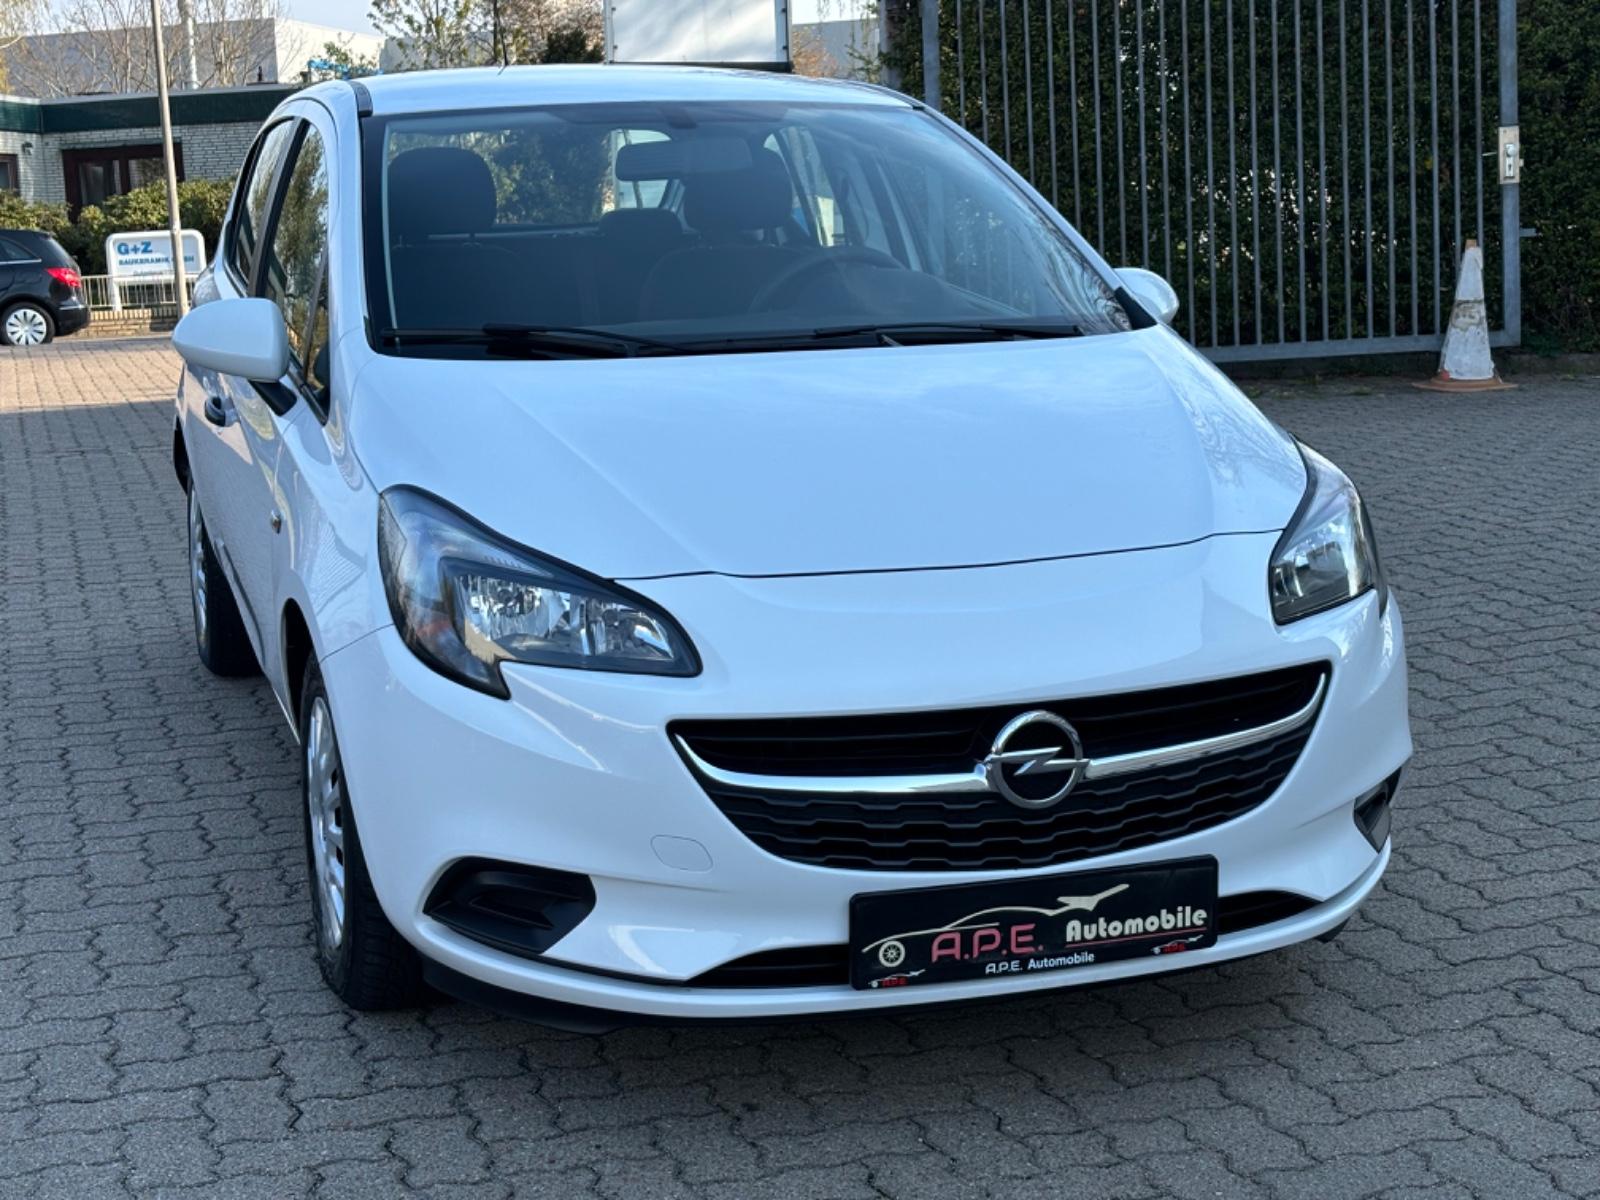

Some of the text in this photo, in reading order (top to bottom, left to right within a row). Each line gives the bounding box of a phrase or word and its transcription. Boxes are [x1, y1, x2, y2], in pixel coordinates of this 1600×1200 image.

[117, 240, 153, 255] G+Z
[931, 905, 1208, 963] A.P.E. Automobile
[985, 951, 1095, 974] A.P.E. Automobile
